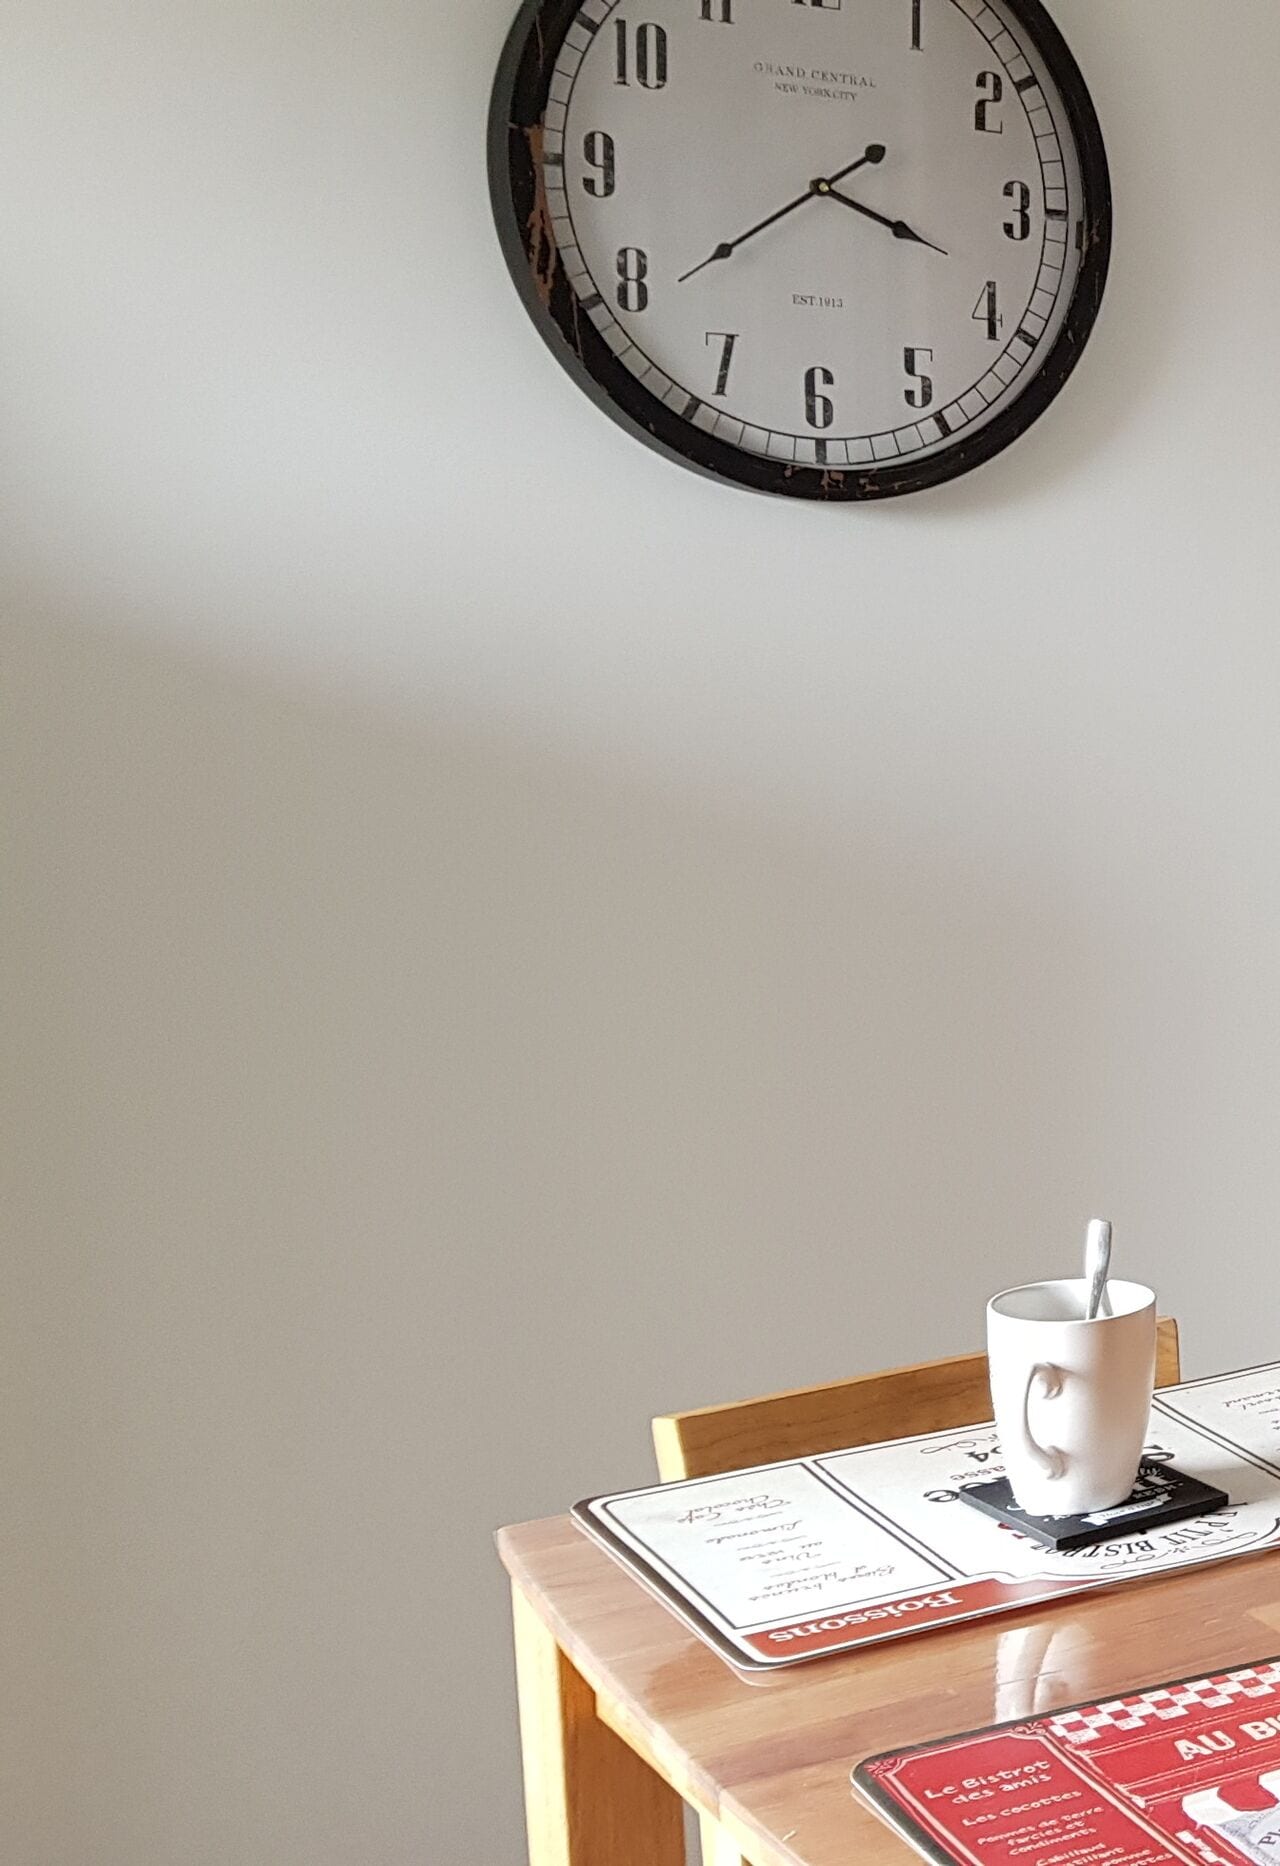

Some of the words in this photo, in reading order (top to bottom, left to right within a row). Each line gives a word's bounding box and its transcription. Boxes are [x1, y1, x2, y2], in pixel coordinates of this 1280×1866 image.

[614, 17, 667, 89] 10
[811, 69, 877, 88] CENTRAL
[774, 82, 800, 94] NEW
[974, 71, 1003, 134] 2
[582, 130, 616, 198] 9
[1002, 180, 1031, 241] 3
[616, 246, 648, 313] 8
[971, 281, 1003, 341] 4
[705, 332, 739, 397] 7
[903, 347, 933, 409] 5
[804, 366, 834, 429] 6
[768, 1591, 963, 1643] Boissons
[1174, 1730, 1236, 1761] AU
[924, 1785, 958, 1800] Le
[961, 1760, 1050, 1790] Bistrot
[952, 1789, 996, 1805] des
[999, 1774, 1052, 1793] amis
[962, 1813, 997, 1827] Les
